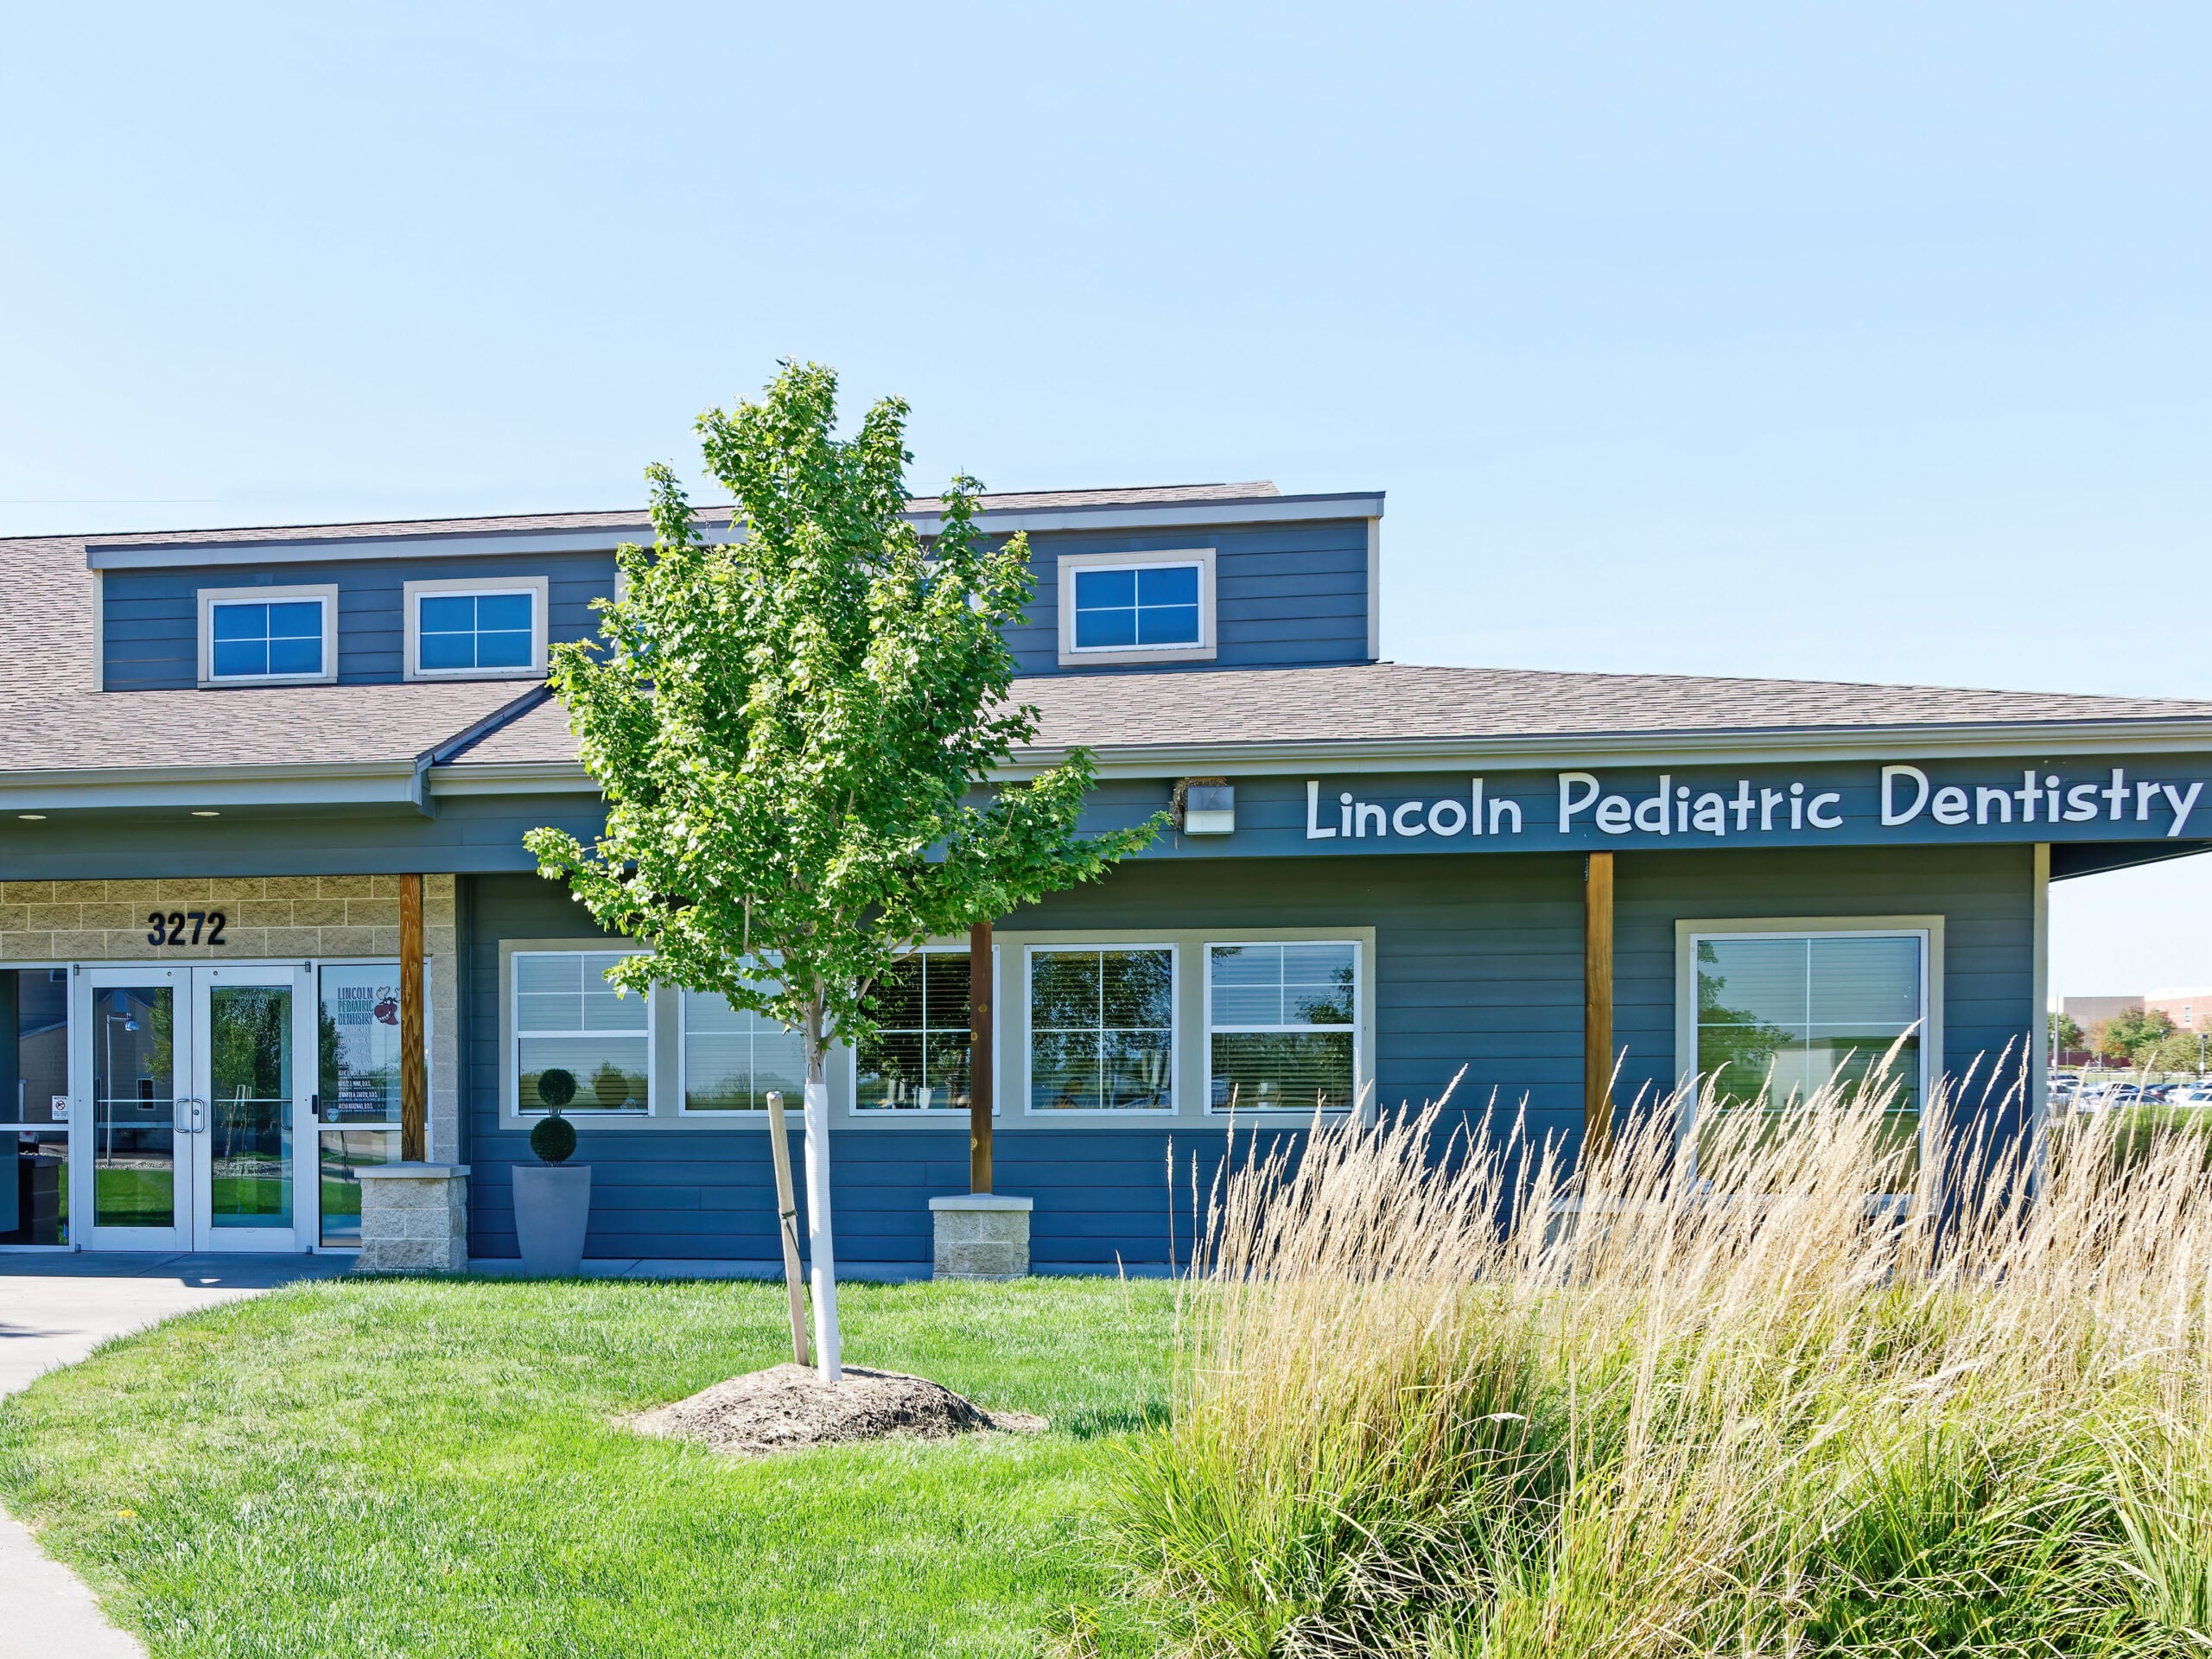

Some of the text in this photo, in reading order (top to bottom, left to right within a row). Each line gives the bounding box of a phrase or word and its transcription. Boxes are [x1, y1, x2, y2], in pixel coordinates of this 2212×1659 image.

[1306, 765, 2203, 839] Lincoln Pediatric Dentistry
[148, 912, 226, 945] 3272
[338, 988, 372, 1000] LINCOLN
[338, 1001, 373, 1012] PEDIATRIC
[338, 1014, 373, 1025] DENTISTRY
